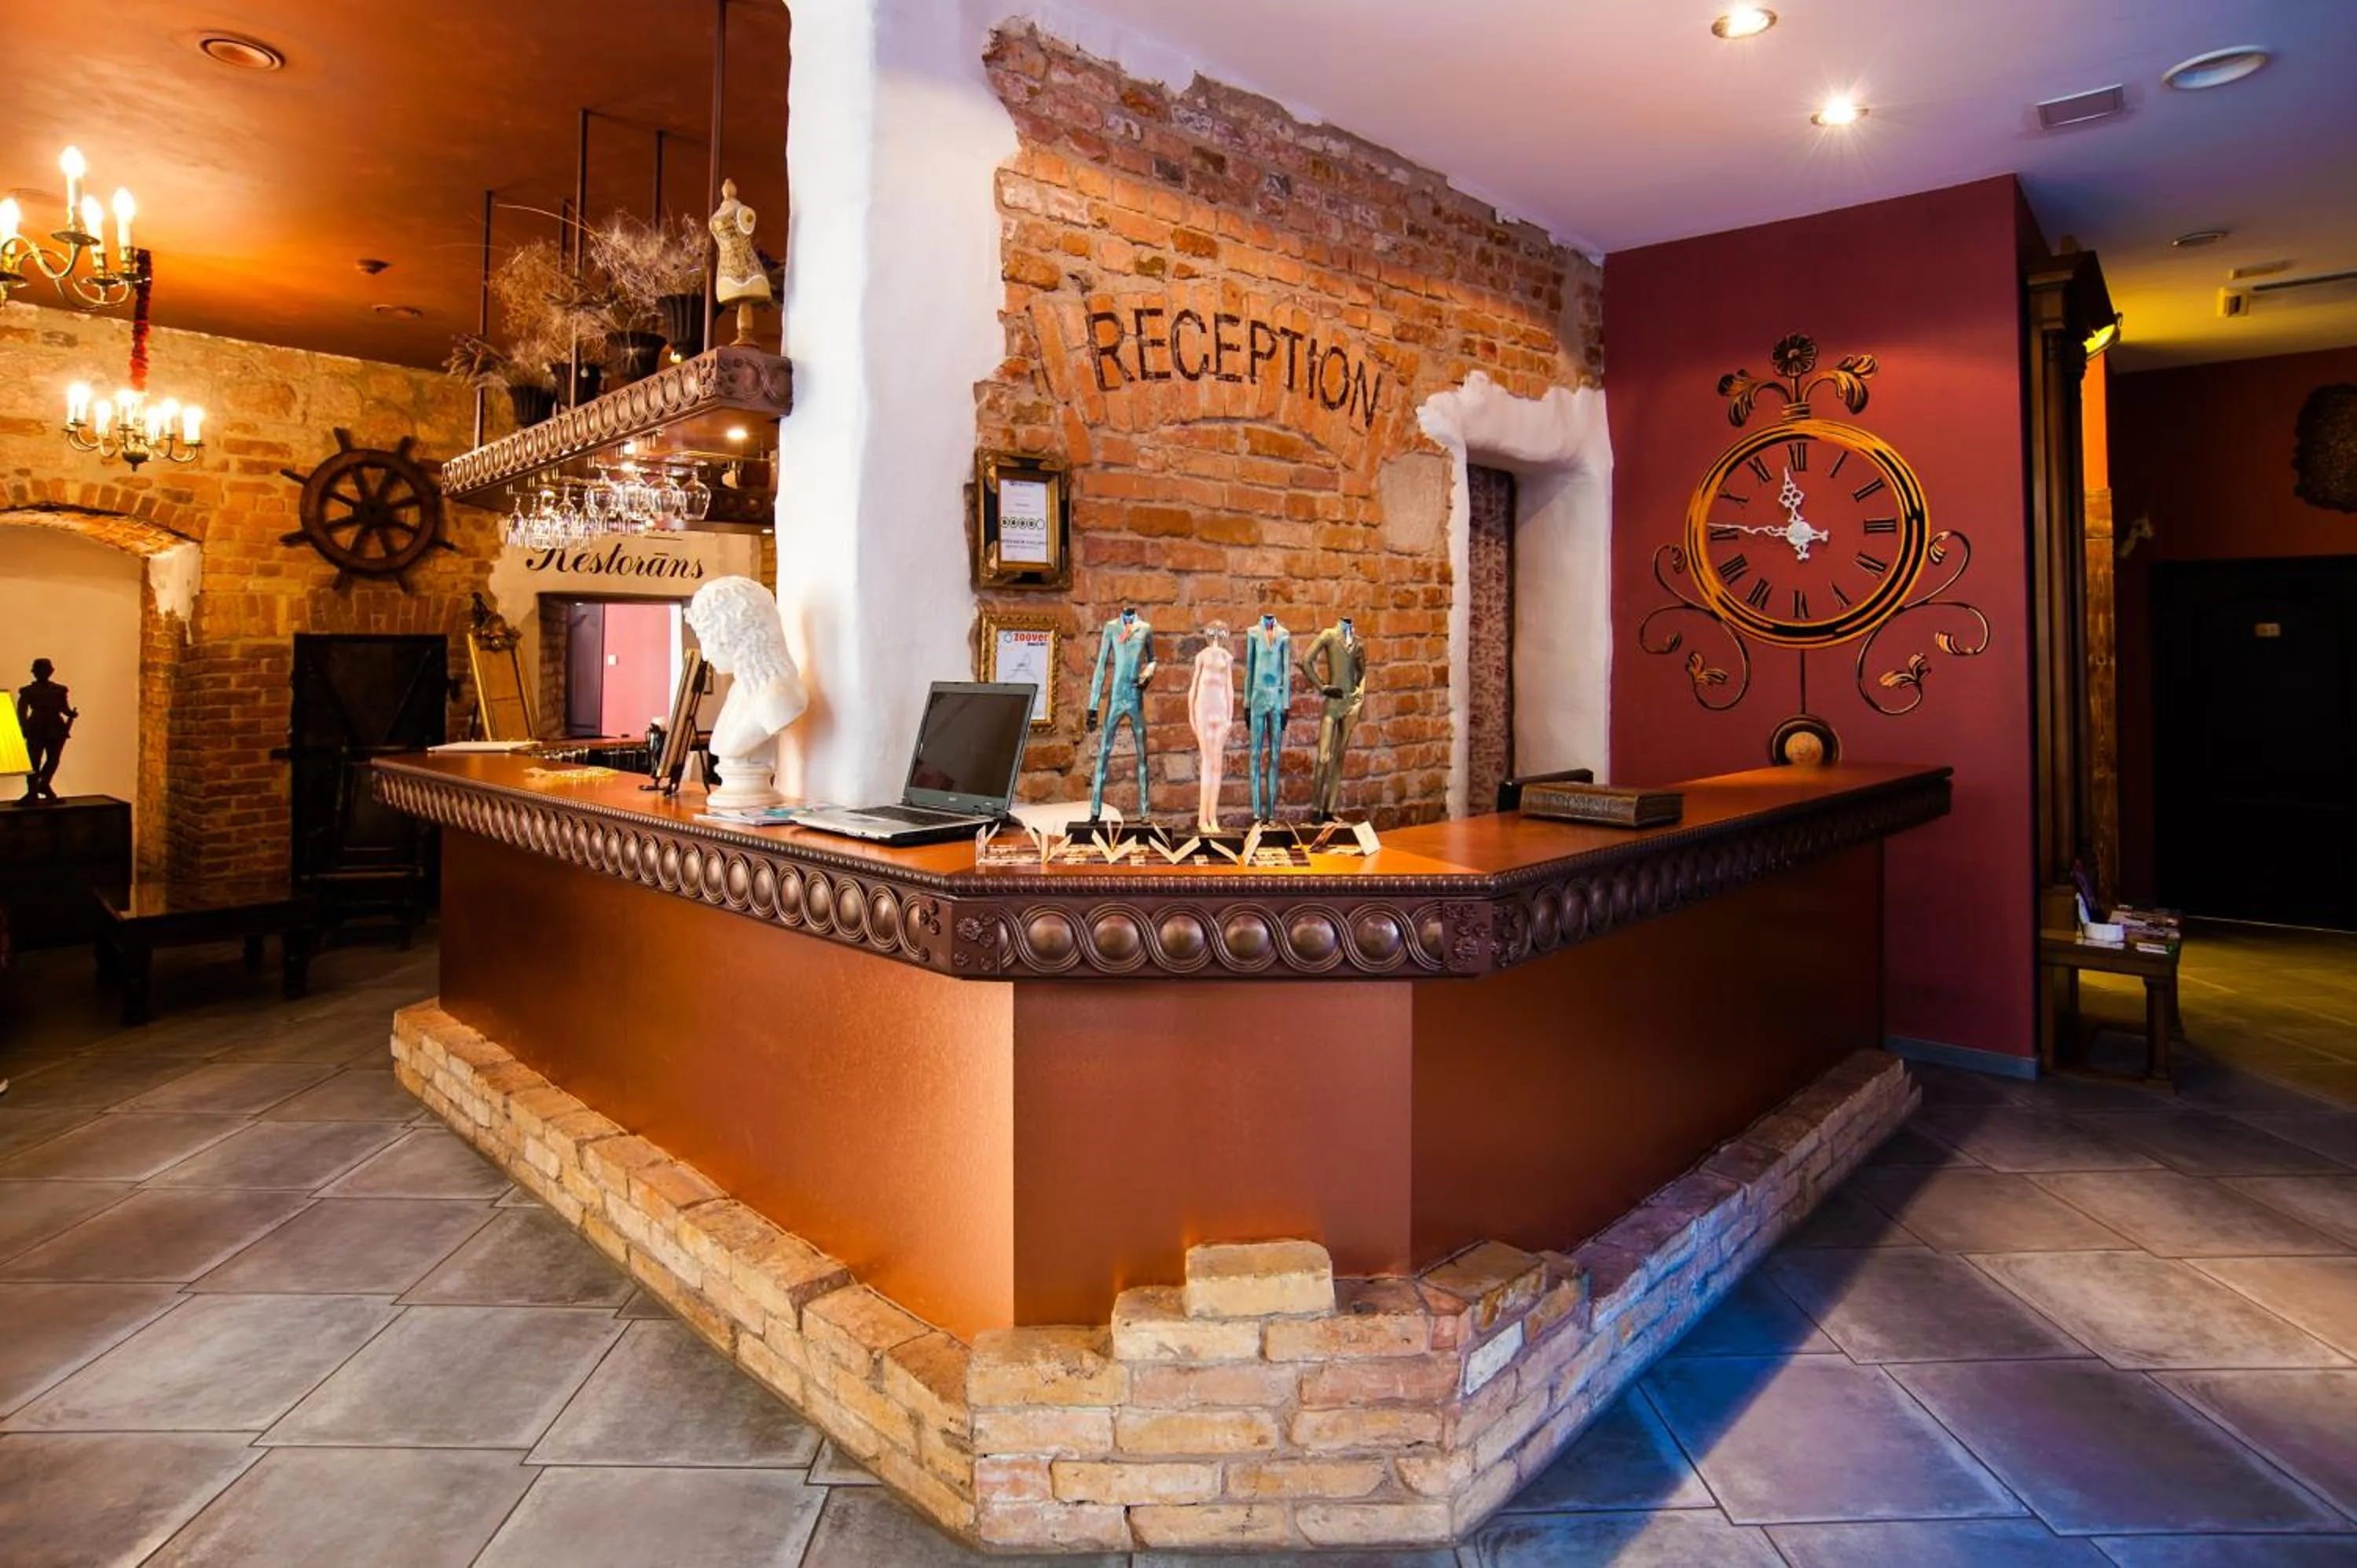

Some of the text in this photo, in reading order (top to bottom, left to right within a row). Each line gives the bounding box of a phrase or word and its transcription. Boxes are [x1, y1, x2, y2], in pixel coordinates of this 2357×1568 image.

[1085, 307, 1384, 427] RECEPTION
[1787, 442, 1807, 472] XII
[526, 542, 704, 580] Restorāns
